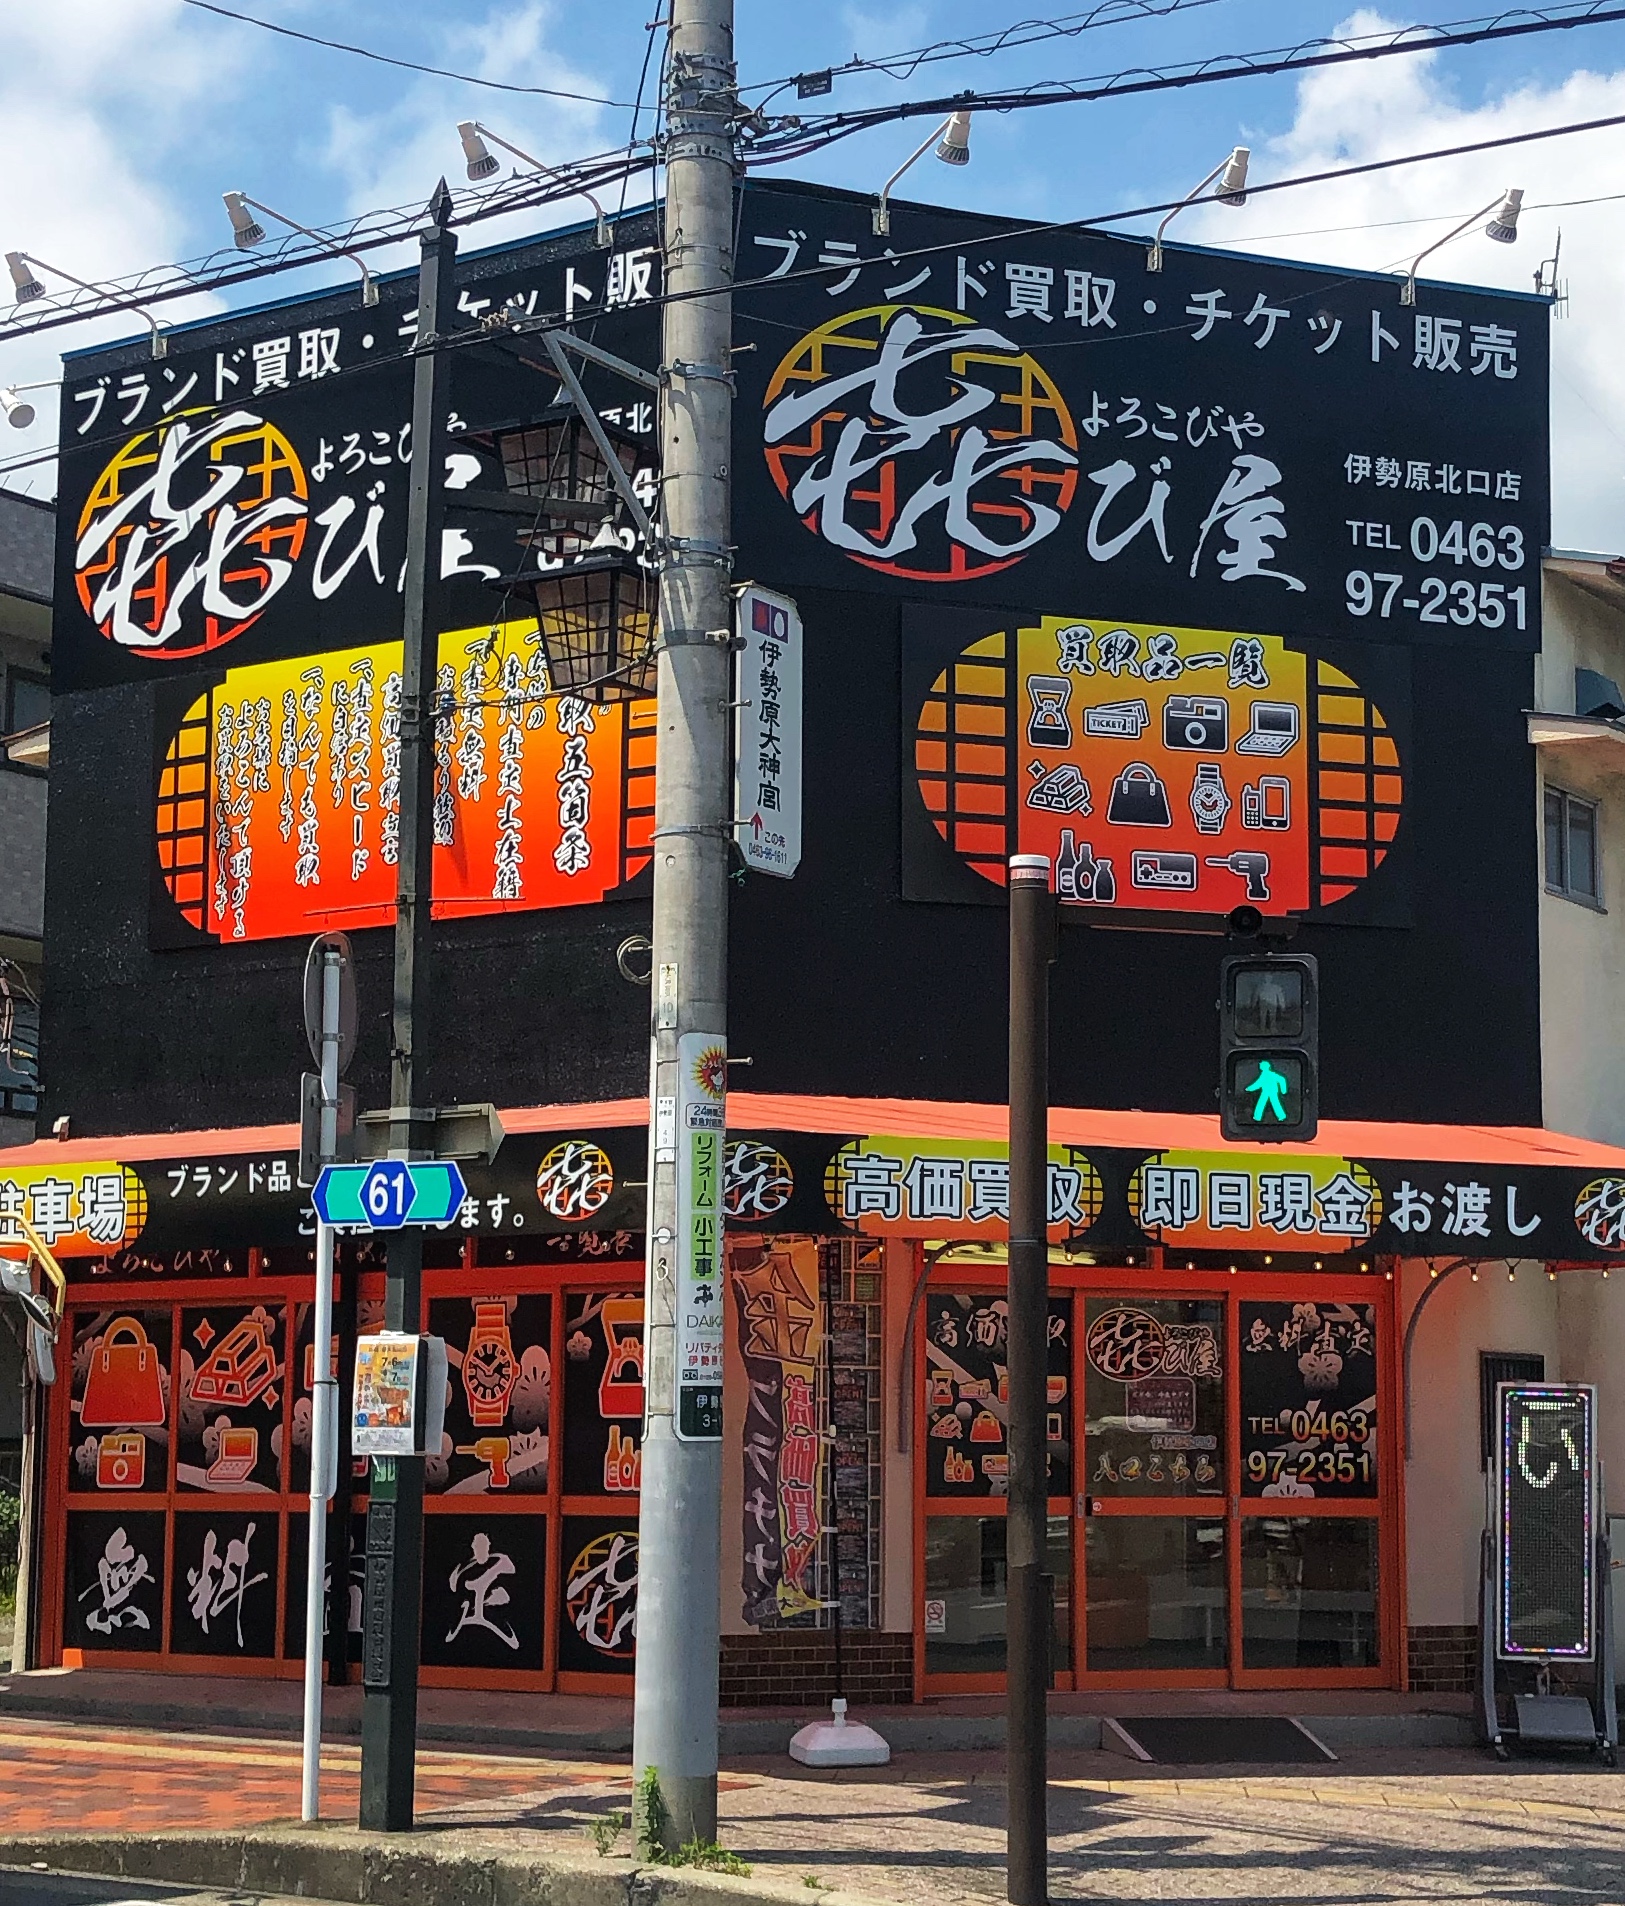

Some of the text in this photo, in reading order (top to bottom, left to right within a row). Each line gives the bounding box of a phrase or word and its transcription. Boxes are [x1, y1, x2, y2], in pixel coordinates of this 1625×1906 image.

[1082, 390, 1265, 451] よろこびや
[1344, 453, 1522, 501] 伊勢原北口店
[1345, 516, 1525, 570] TEL 0463
[1345, 570, 1526, 630] 97-2351
[1055, 624, 1270, 689] 買取品一覧
[757, 639, 782, 812] 伊勢原大神宮
[1091, 718, 1123, 729] TICKET
[764, 831, 786, 848] この先
[167, 1159, 313, 1198] ブランド品
[369, 1172, 404, 1216] 61
[696, 1135, 713, 1207] リフォーム
[1142, 1166, 1372, 1237] 即日現金
[1389, 1180, 1541, 1238] お渡し
[695, 1217, 713, 1277] 小工事
[1248, 1410, 1369, 1442] TEL 0463
[1248, 1450, 1370, 1483] 97-2351
